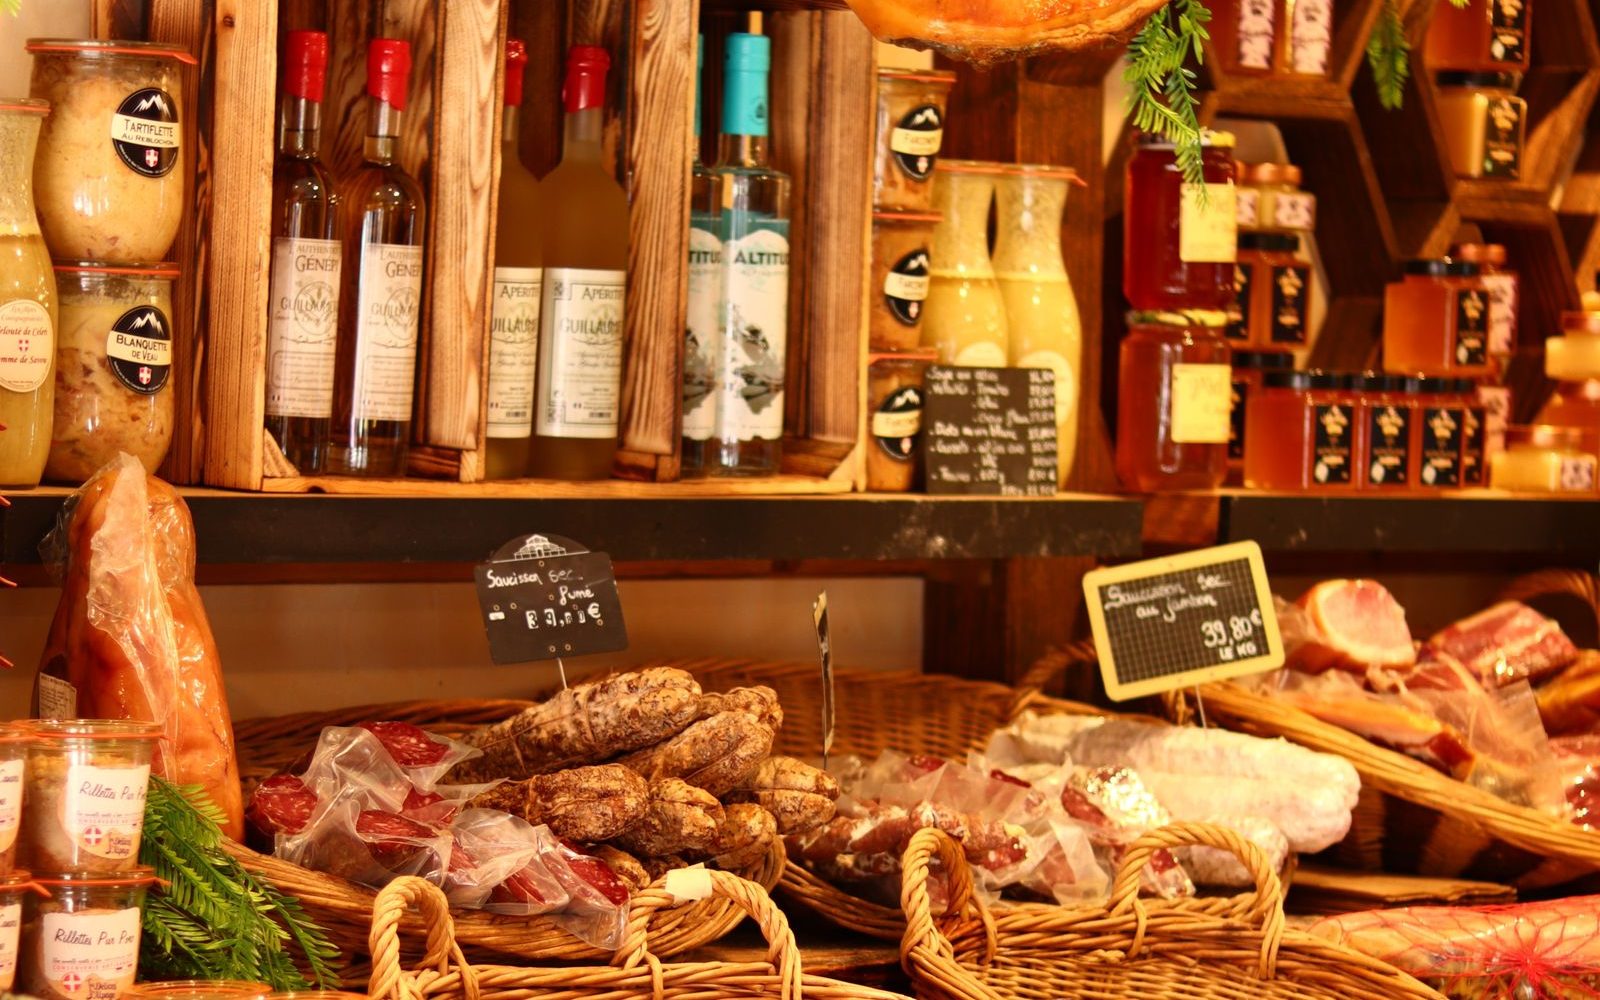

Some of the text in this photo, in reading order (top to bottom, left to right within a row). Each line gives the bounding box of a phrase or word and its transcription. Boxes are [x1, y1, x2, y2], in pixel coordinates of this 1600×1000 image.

[125, 119, 173, 137] TARTIFLETTE
[117, 335, 168, 352] BLANQUETTE
[132, 350, 158, 361] DE VEAU
[487, 570, 543, 588] Saucisson
[559, 585, 594, 606] fumé
[1104, 583, 1187, 611] Saucisson
[1136, 593, 1217, 623] au jambon
[1219, 646, 1233, 660] LE
[80, 781, 116, 800] Rillettes
[120, 785, 135, 800] Pur
[55, 928, 92, 945] Rillettes
[98, 931, 114, 945] Pur
